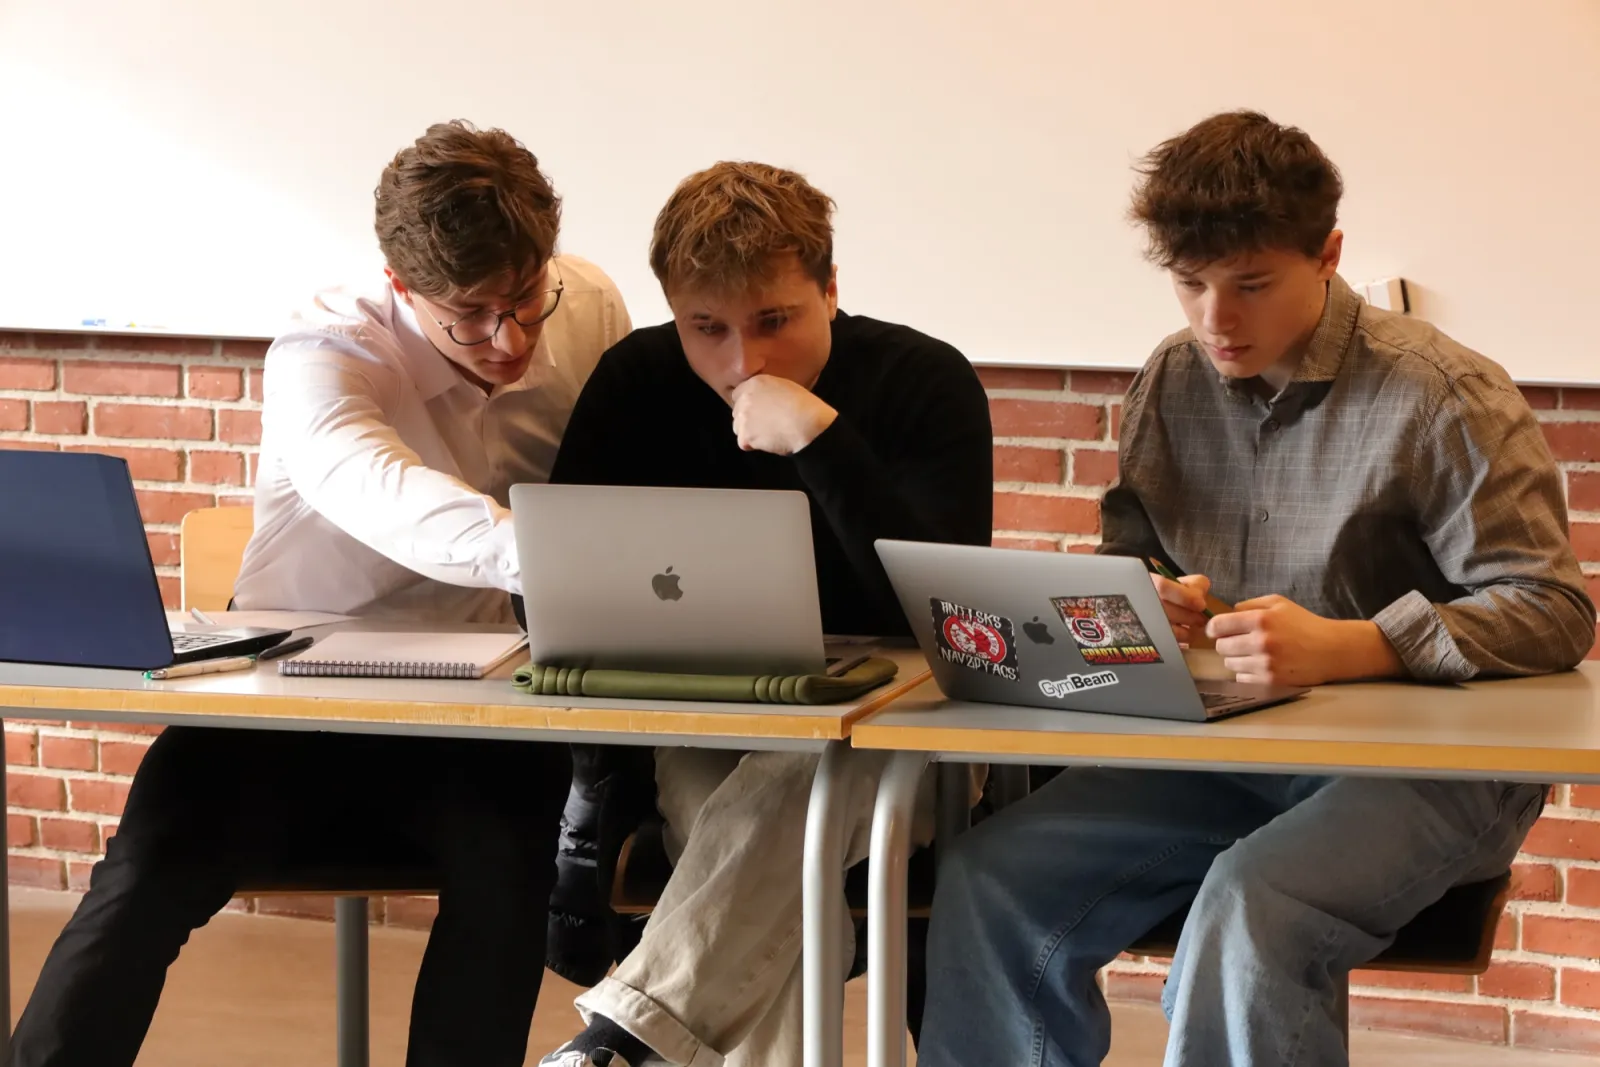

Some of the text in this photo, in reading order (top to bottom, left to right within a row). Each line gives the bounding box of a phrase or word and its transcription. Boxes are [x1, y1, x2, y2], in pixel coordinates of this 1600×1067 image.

[940, 601, 1002, 629] ANTI SKS
[1041, 672, 1116, 697] GymBeam
